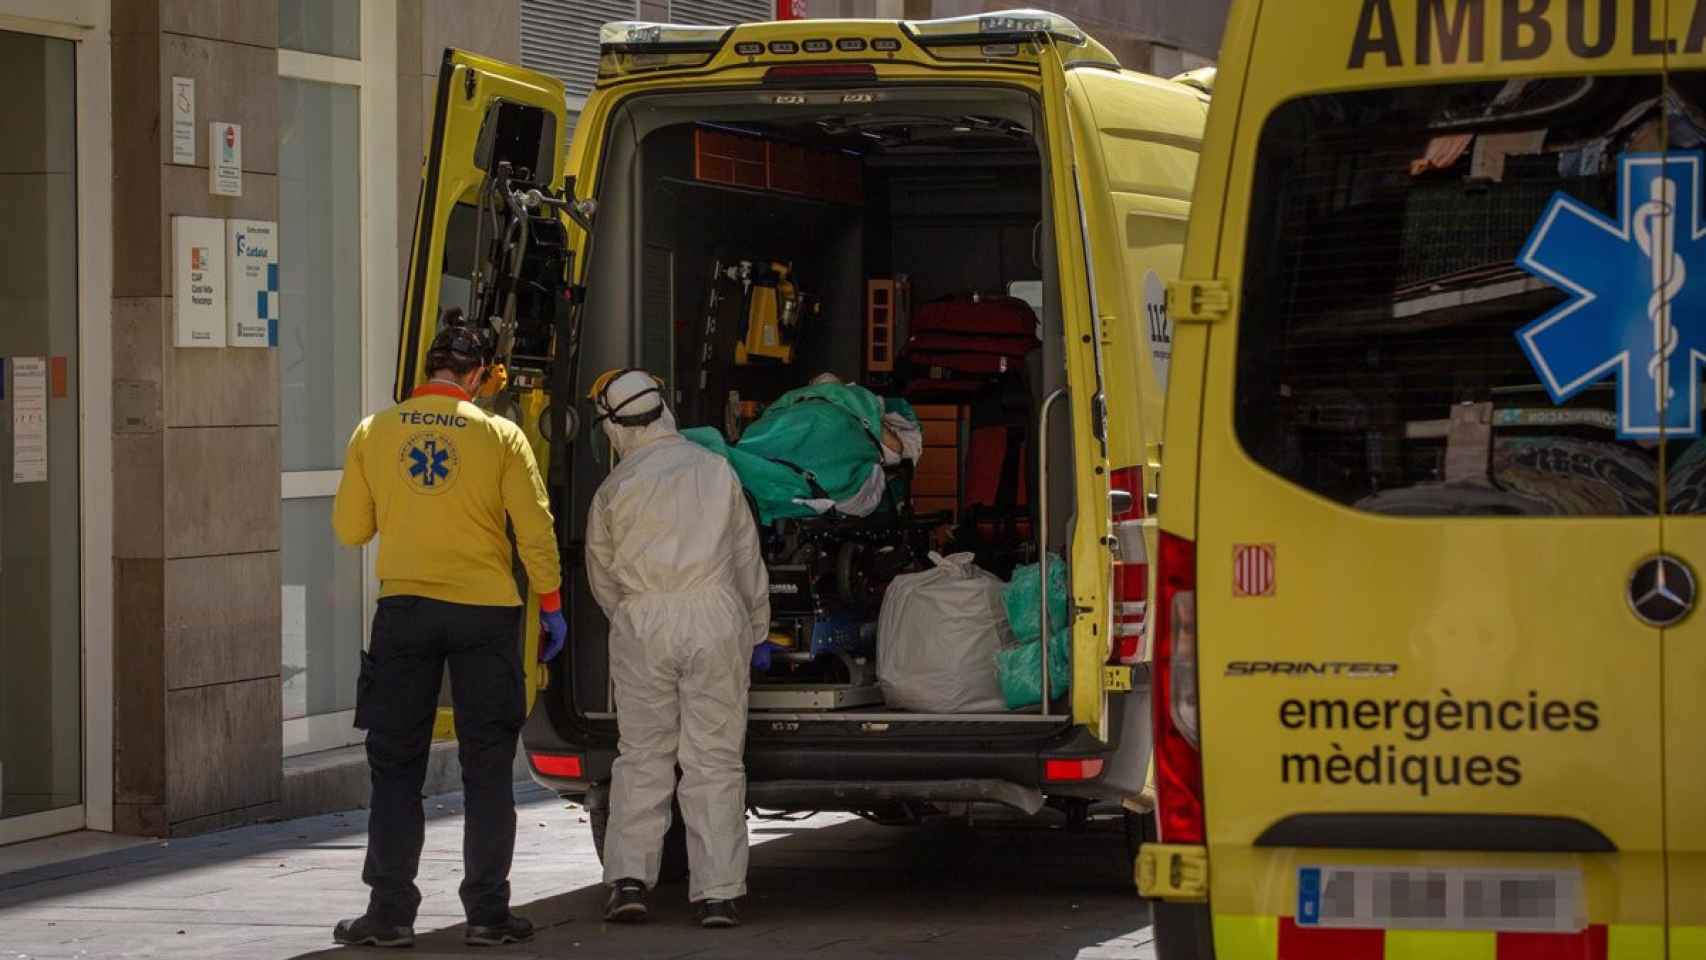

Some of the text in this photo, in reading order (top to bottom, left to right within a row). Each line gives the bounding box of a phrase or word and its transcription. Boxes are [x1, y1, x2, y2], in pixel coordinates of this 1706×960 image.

[1225, 661, 1399, 677] SPRINTER
[1278, 688, 1600, 741] emergències
[1280, 742, 1523, 797] mèdiques
